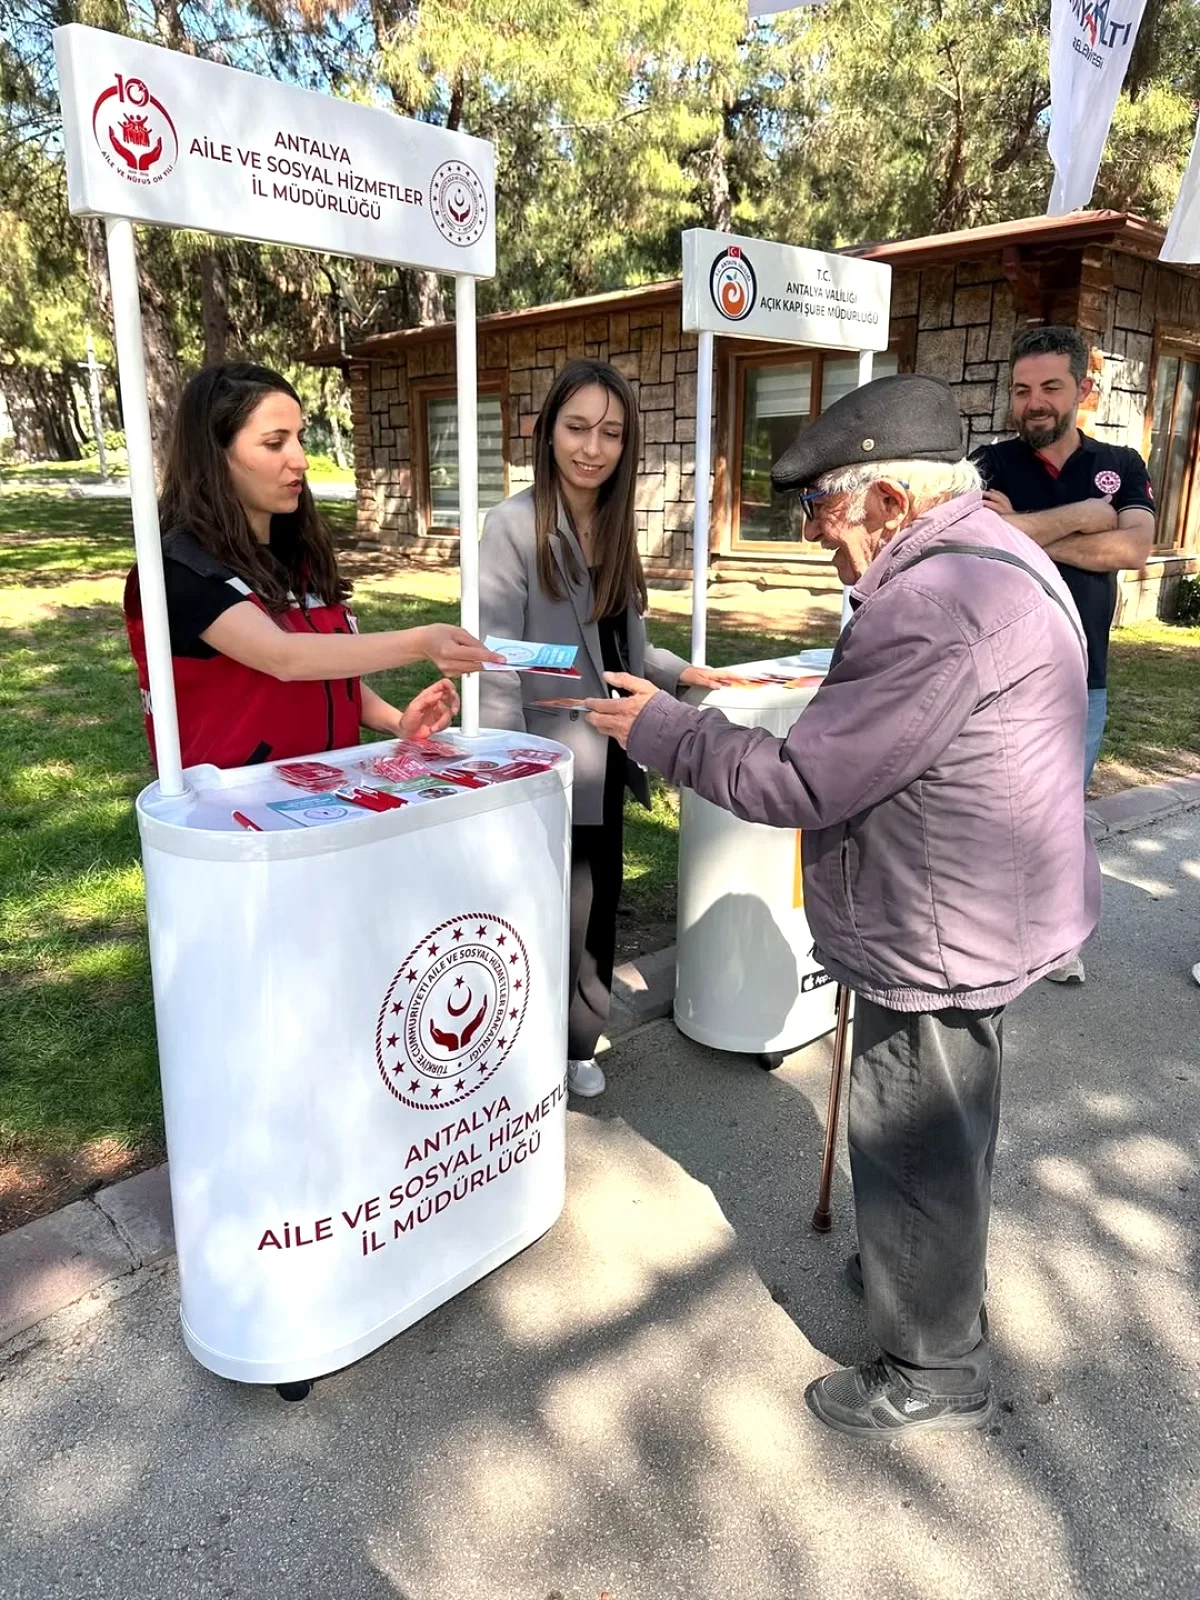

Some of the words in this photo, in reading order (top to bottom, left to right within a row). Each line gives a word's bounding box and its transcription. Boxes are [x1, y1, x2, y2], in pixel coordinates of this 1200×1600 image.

[274, 131, 351, 164] ANTALYA
[189, 136, 233, 163] AİLE
[237, 148, 262, 169] VE
[267, 156, 334, 186] SOSYAL
[337, 171, 424, 207] HİZMETLER
[252, 174, 268, 197] İL
[273, 182, 381, 220] MÜDÜRLÜĞÜ
[817, 269, 831, 282] T.C.
[786, 282, 823, 298] ANTALYA
[760, 296, 782, 312] AÇIK
[782, 299, 803, 313] KAPI
[804, 302, 825, 317] ŞUBE
[446, 952, 458, 965] VE
[460, 948, 489, 961] SOSYAL
[428, 961, 446, 984] AİLE
[489, 956, 507, 1007] HİZMETLER
[416, 1054, 448, 1075] TÜRKİYE
[404, 1095, 511, 1169] ANTALYA
[257, 1217, 333, 1250] AİLE
[341, 1196, 381, 1229] VE
[389, 1143, 482, 1209] SOSYAL
[489, 1073, 567, 1151] HİZMETLE
[362, 1230, 386, 1256] İL
[393, 1129, 541, 1239] MÜDÜRLÜĞÜ
